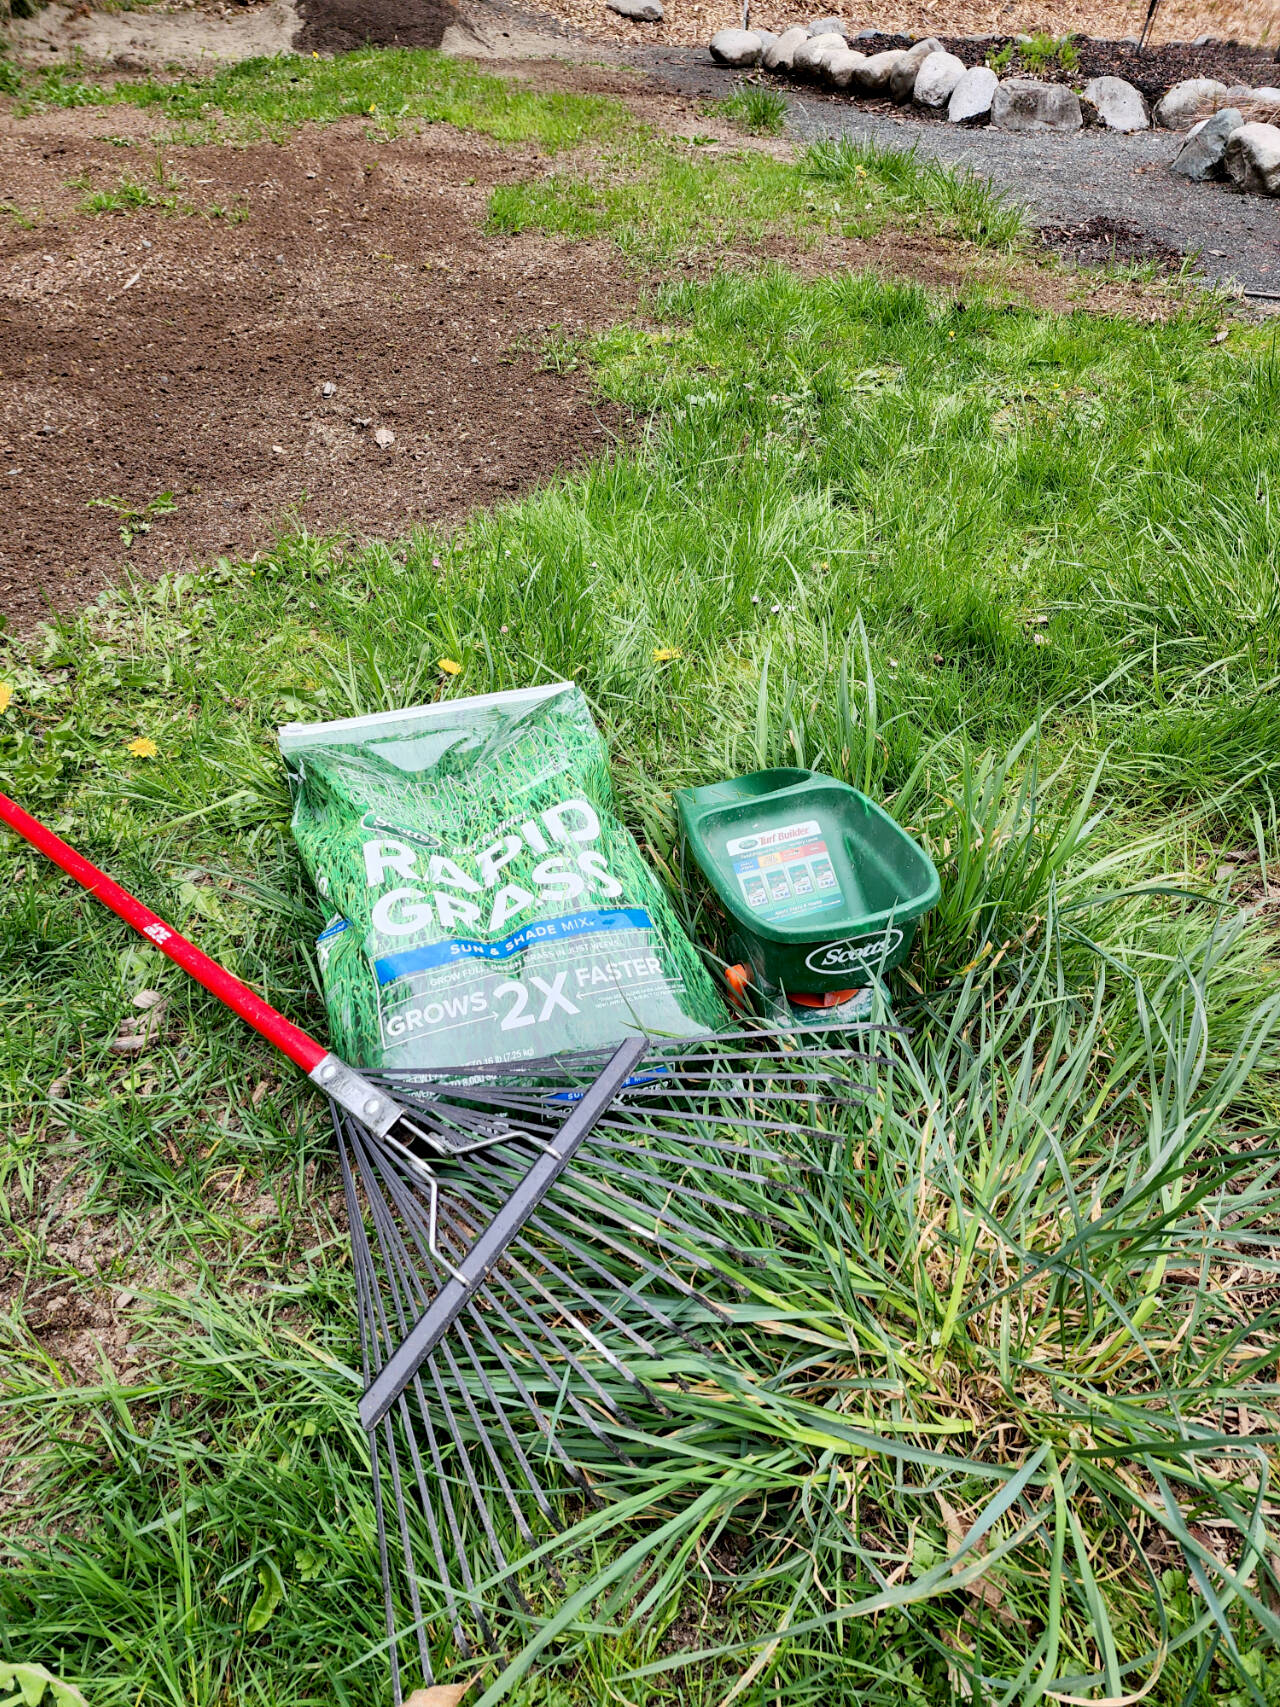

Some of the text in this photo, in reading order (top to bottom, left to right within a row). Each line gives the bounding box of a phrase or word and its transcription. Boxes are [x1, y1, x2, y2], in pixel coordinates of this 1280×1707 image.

[363, 799, 600, 892] RAPID
[759, 832, 776, 846] Turf
[777, 826, 809, 841] Builder
[372, 850, 622, 935] GRASS
[450, 943, 485, 955] SUN
[489, 947, 500, 956] &
[504, 926, 557, 952] SHADE
[429, 971, 460, 986] GROW
[568, 943, 589, 954] JUST
[386, 991, 488, 1037] GROWS
[493, 971, 581, 1031] 2X
[575, 957, 664, 988] FASTER
[486, 1056, 494, 1065] 16
